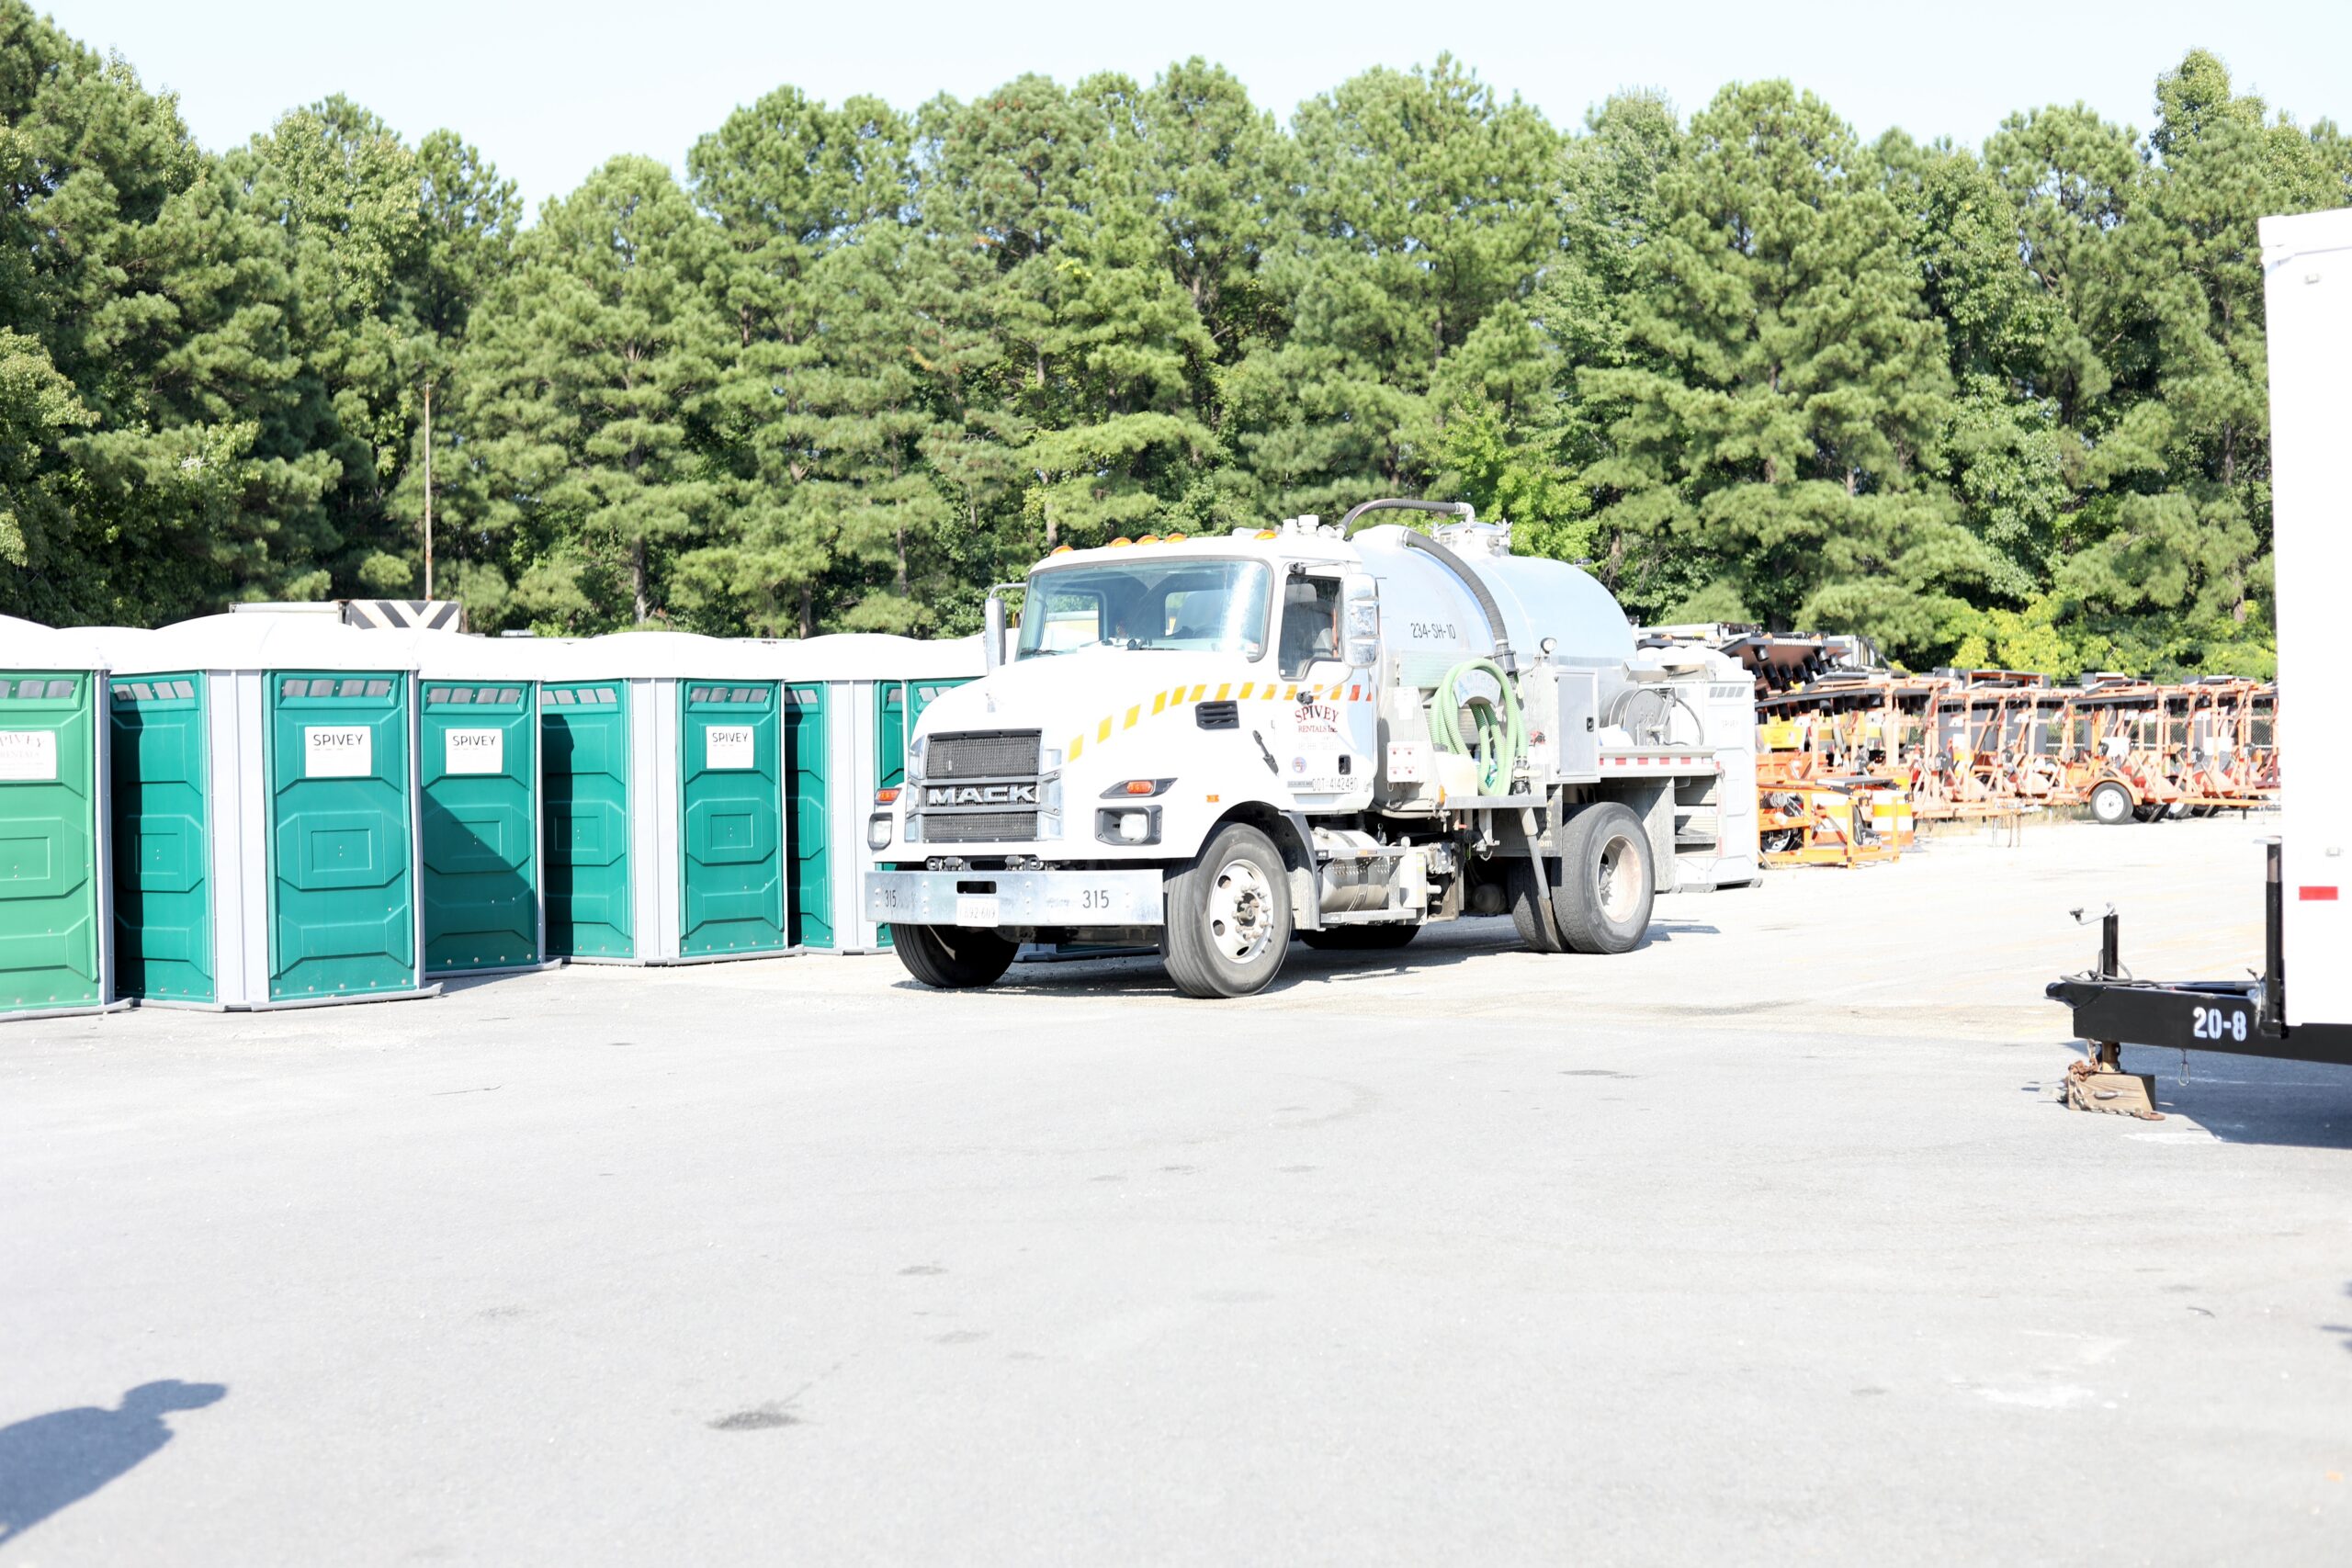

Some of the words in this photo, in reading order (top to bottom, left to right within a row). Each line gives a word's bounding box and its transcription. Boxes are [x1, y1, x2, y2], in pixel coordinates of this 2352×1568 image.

[1410, 622, 1456, 640] 234-SH-10
[1295, 705, 1340, 724] SPIVEY
[712, 732, 749, 743] SPIVEY
[1298, 725, 1327, 733] RENTALS
[0, 733, 44, 749] PIVEY
[312, 733, 364, 747] SPIVEY
[452, 735, 496, 747] SPIVEY
[928, 784, 1036, 805] MACK
[884, 889, 897, 908] 315
[1082, 889, 1110, 909] 315
[2192, 1006, 2247, 1042] 20-8
